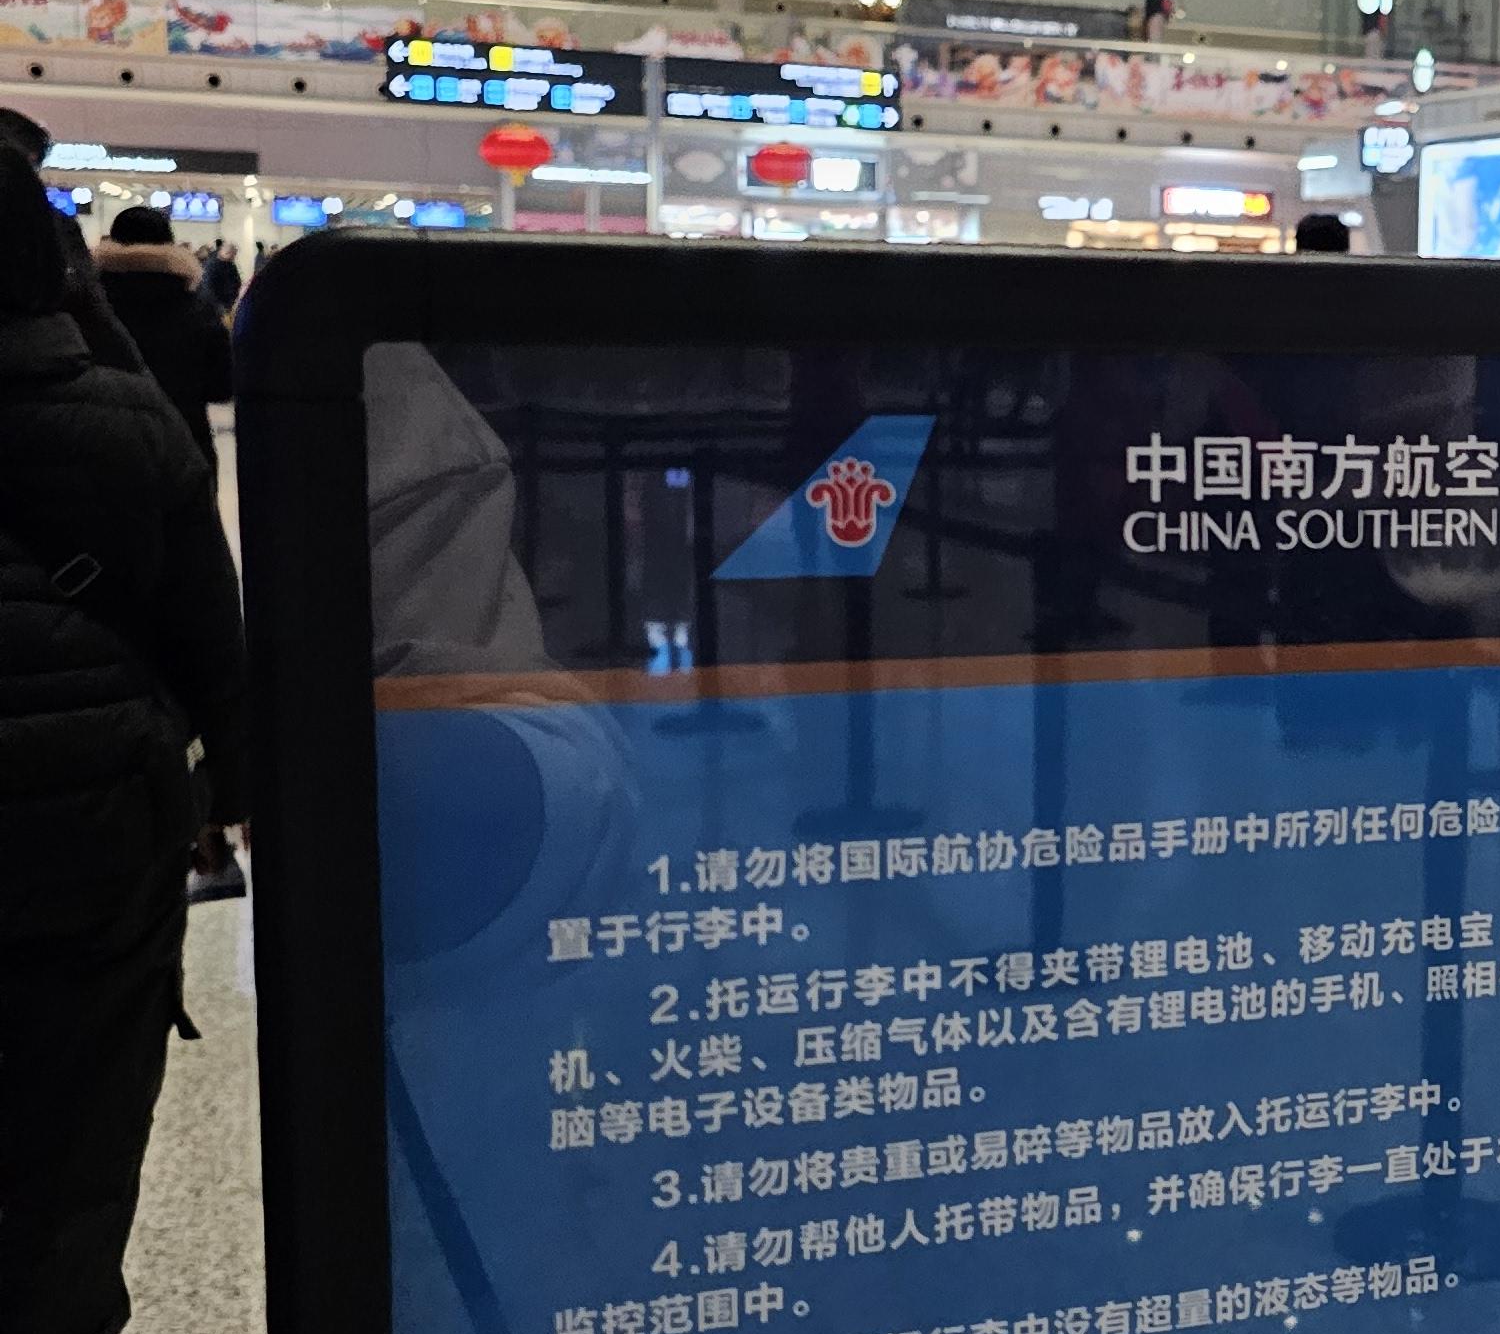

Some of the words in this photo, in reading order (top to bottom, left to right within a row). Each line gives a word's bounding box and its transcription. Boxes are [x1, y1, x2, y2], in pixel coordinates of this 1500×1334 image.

[1122, 509, 1260, 553] CHINA
[1275, 507, 1499, 551] SOUTHERN
[547, 902, 811, 962] 置于行李中。
[549, 1068, 986, 1152] 脑等电子设备类物品。
[651, 1079, 1461, 1209] 3.请勿将贵重或易碎等物品放入托运行李中。
